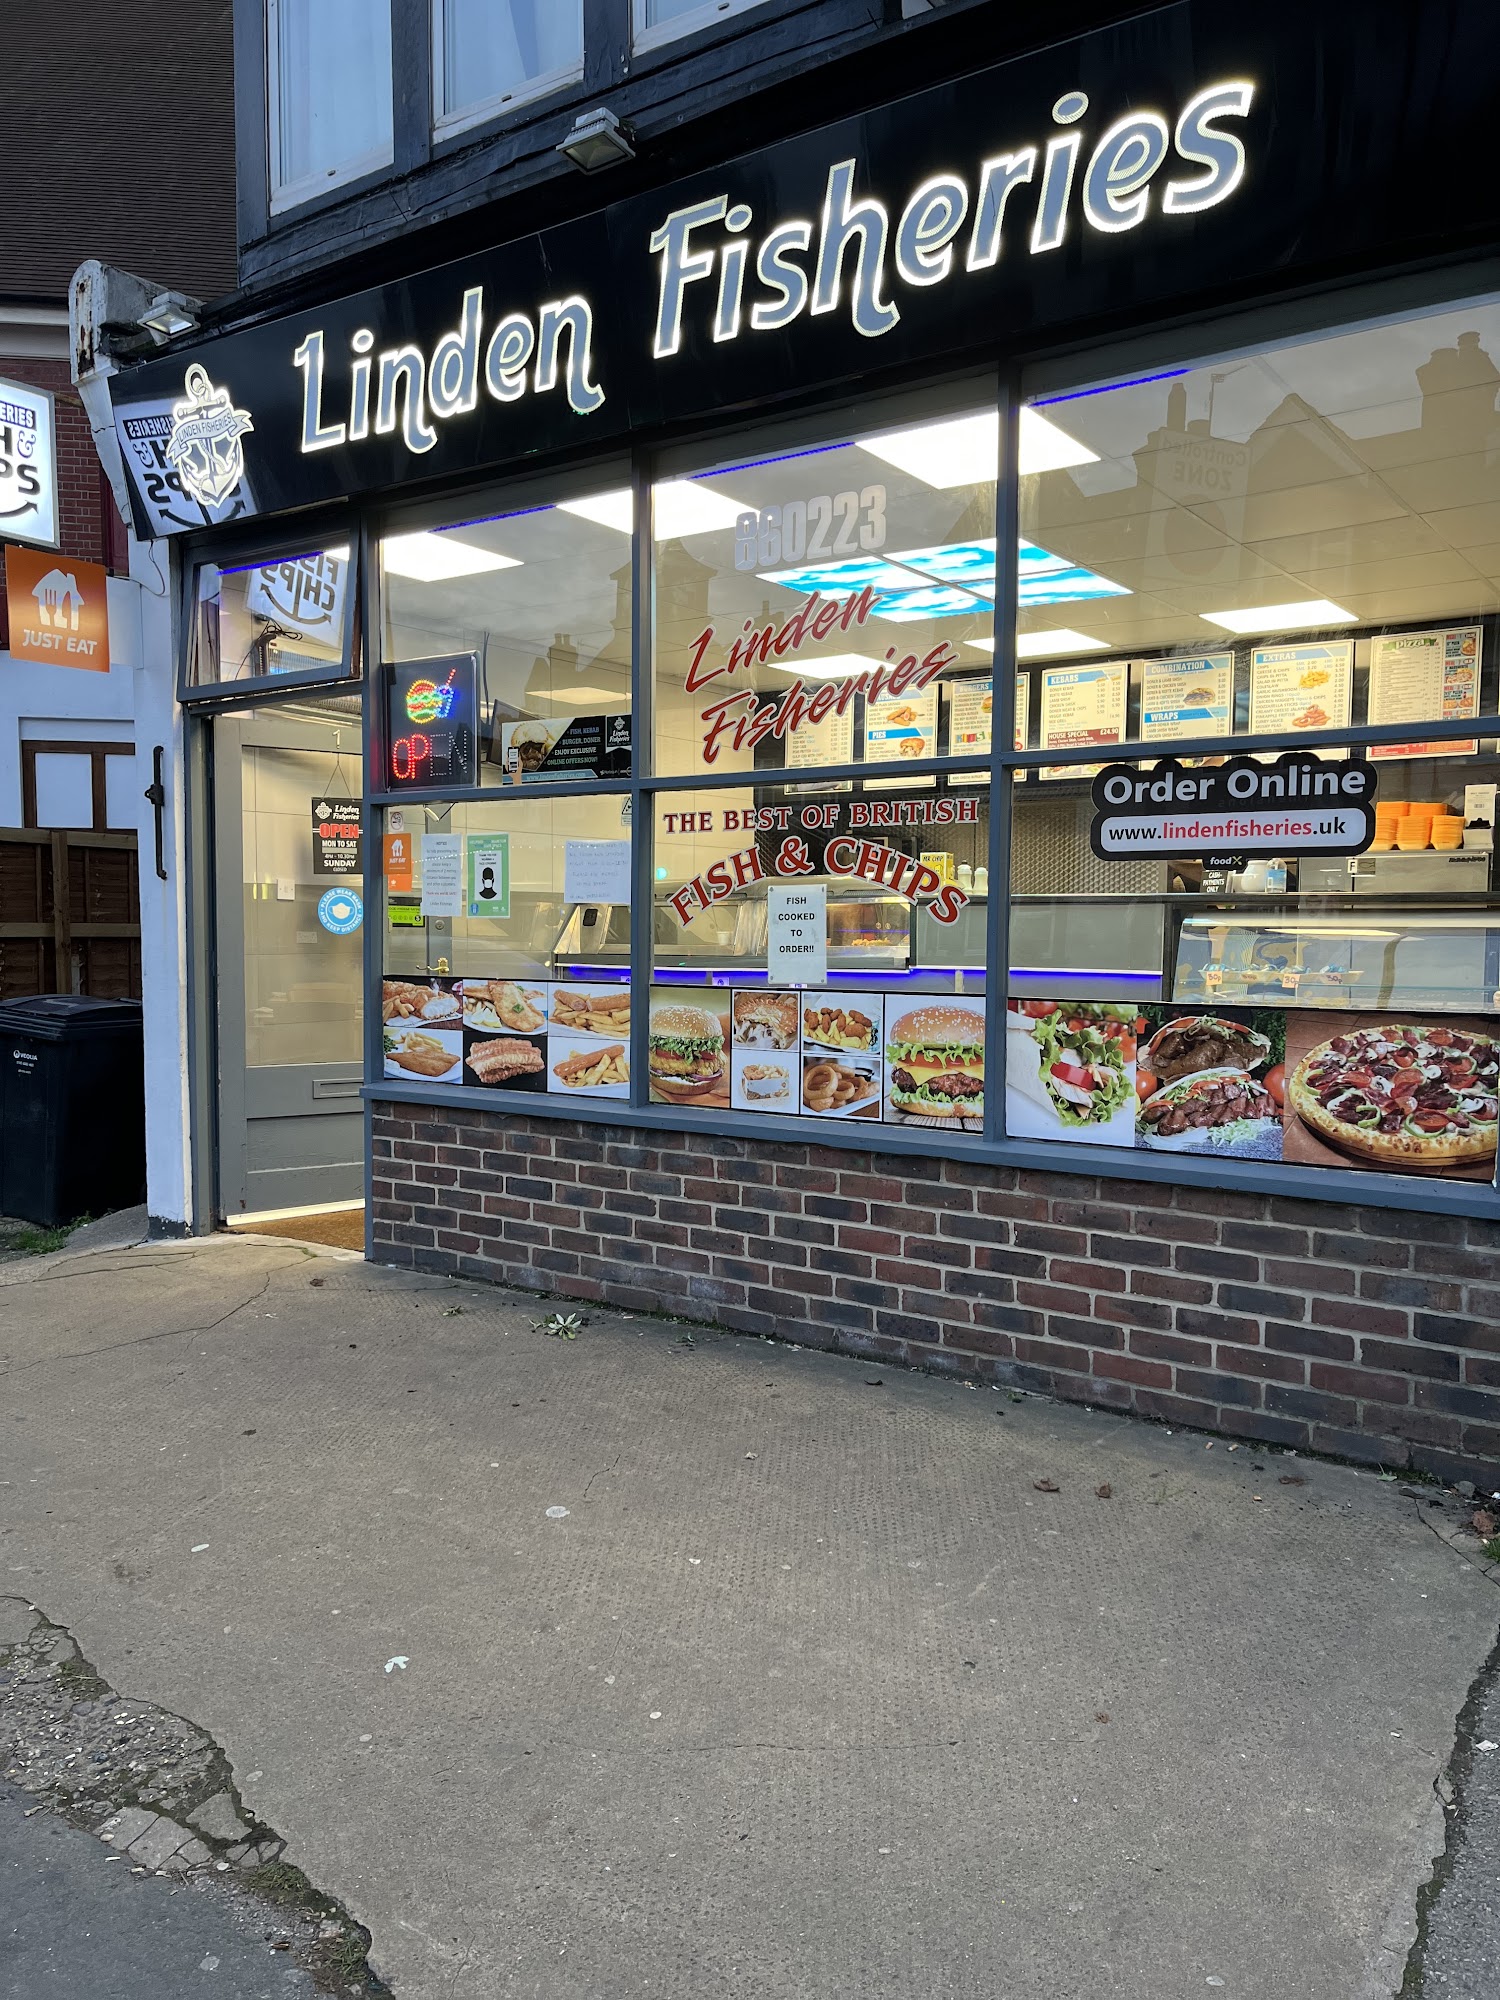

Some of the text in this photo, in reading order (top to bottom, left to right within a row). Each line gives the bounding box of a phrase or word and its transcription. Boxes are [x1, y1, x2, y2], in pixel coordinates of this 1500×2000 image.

[294, 82, 1255, 454] Linden Fisheries
[0, 402, 35, 431] ERIES
[179, 413, 232, 442] LINDEN FISHERIES
[734, 484, 887, 571] 860223
[23, 629, 97, 655] JUST EAT
[684, 584, 884, 694] Linden
[1263, 652, 1296, 662] EXTRAS
[1152, 661, 1205, 673] COMBINATION
[960, 683, 989, 692] BURGERS
[1051, 674, 1078, 684] KEBABS
[701, 639, 960, 766] Fisheries
[1150, 712, 1178, 721] WRAPS
[873, 731, 886, 739] PIES
[392, 730, 467, 779] OPEN
[570, 747, 596, 755] EXCLUSIVE
[1103, 764, 1366, 805] Order Online
[333, 813, 360, 821] Fisheries
[335, 805, 360, 814] Linden
[664, 797, 980, 834] THE BEST OF BRITISH
[320, 823, 359, 838] OPEN
[1109, 818, 1346, 841] www.lindenfisheries.uk
[666, 843, 766, 928] FISH
[775, 835, 816, 877] &
[823, 835, 971, 928] CHIPS
[321, 891, 335, 908] PLEASE
[352, 895, 361, 909] MASK
[327, 923, 340, 931] KEEP
[341, 914, 361, 932] DISTANCE
[778, 913, 815, 921] COOKED
[779, 945, 814, 953] ORDER!!
[1284, 977, 1298, 985] 30p
